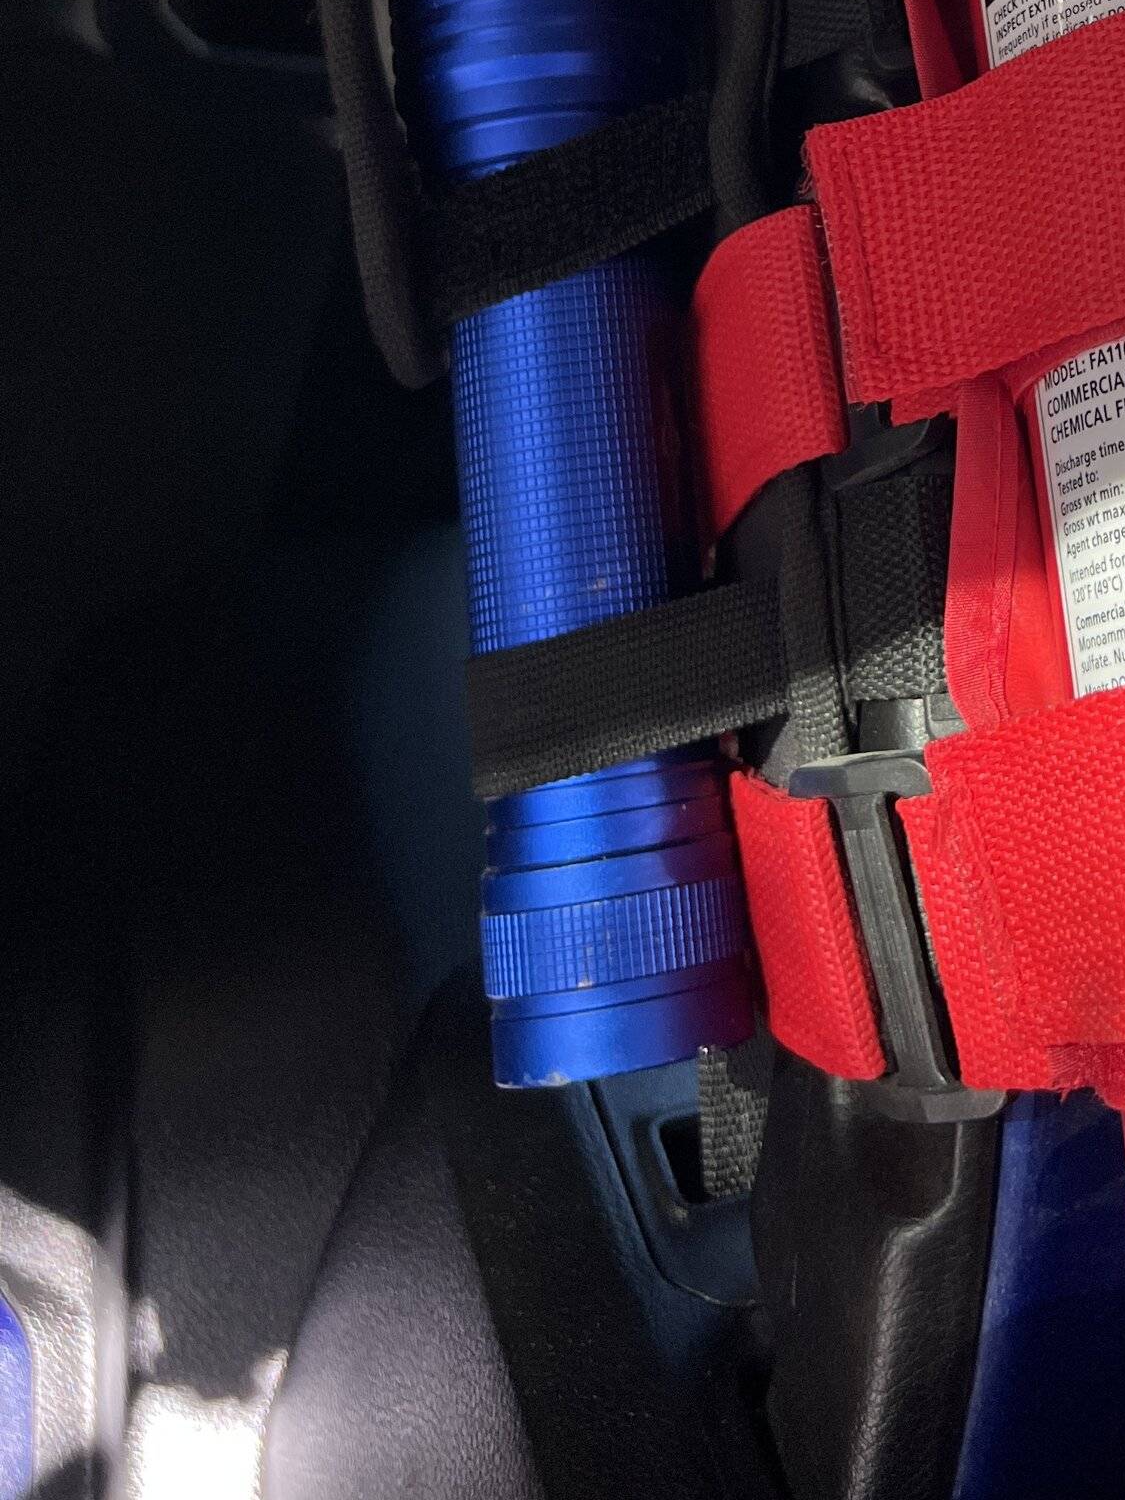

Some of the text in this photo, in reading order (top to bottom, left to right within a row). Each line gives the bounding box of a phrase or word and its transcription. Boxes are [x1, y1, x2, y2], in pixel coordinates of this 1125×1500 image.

[996, 8, 1027, 41] INSPECT
[998, 22, 1040, 61] frequently
[1041, 15, 1050, 29] if
[1044, 359, 1087, 391] MODEL:
[1051, 404, 1112, 444] CHEMICAL
[1055, 450, 1097, 477] Discharge
[1057, 472, 1084, 496] Tested
[1085, 470, 1100, 486] to:
[1060, 497, 1082, 517] Gross
[1083, 489, 1098, 506] wt
[1100, 482, 1125, 502] min:
[1063, 518, 1085, 537] Gross
[1086, 512, 1101, 528] wt
[1066, 539, 1090, 560] Agent
[1069, 560, 1108, 585] Intended
[1081, 654, 1112, 675] sulfate.
